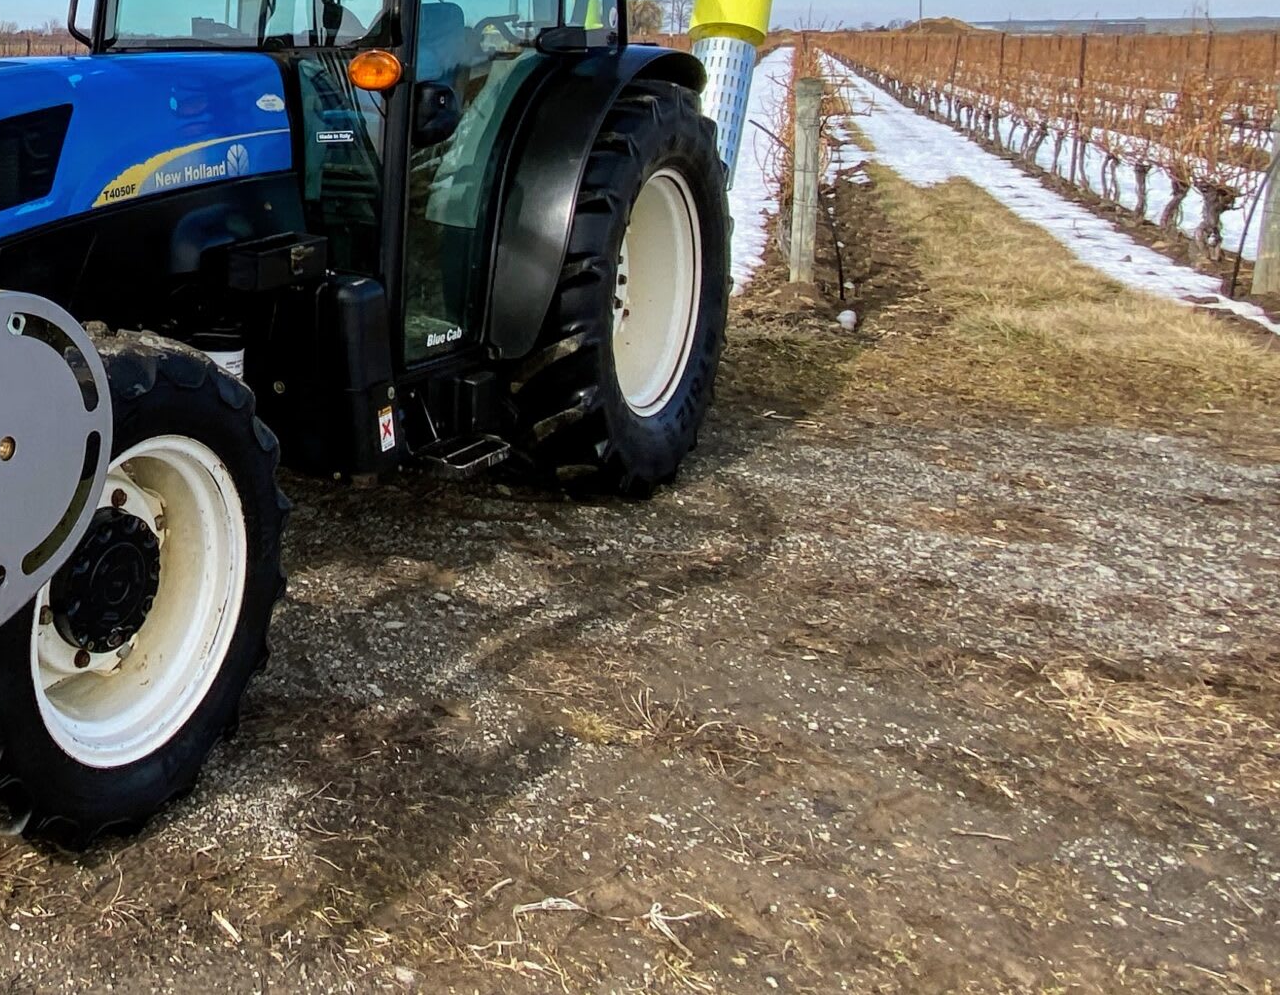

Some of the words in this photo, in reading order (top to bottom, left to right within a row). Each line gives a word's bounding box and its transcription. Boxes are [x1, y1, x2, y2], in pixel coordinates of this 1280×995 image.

[154, 171, 182, 188] New
[184, 160, 226, 182] Holland
[103, 183, 137, 201] T4050F
[426, 333, 445, 347] Blue
[446, 326, 462, 342] Cab
